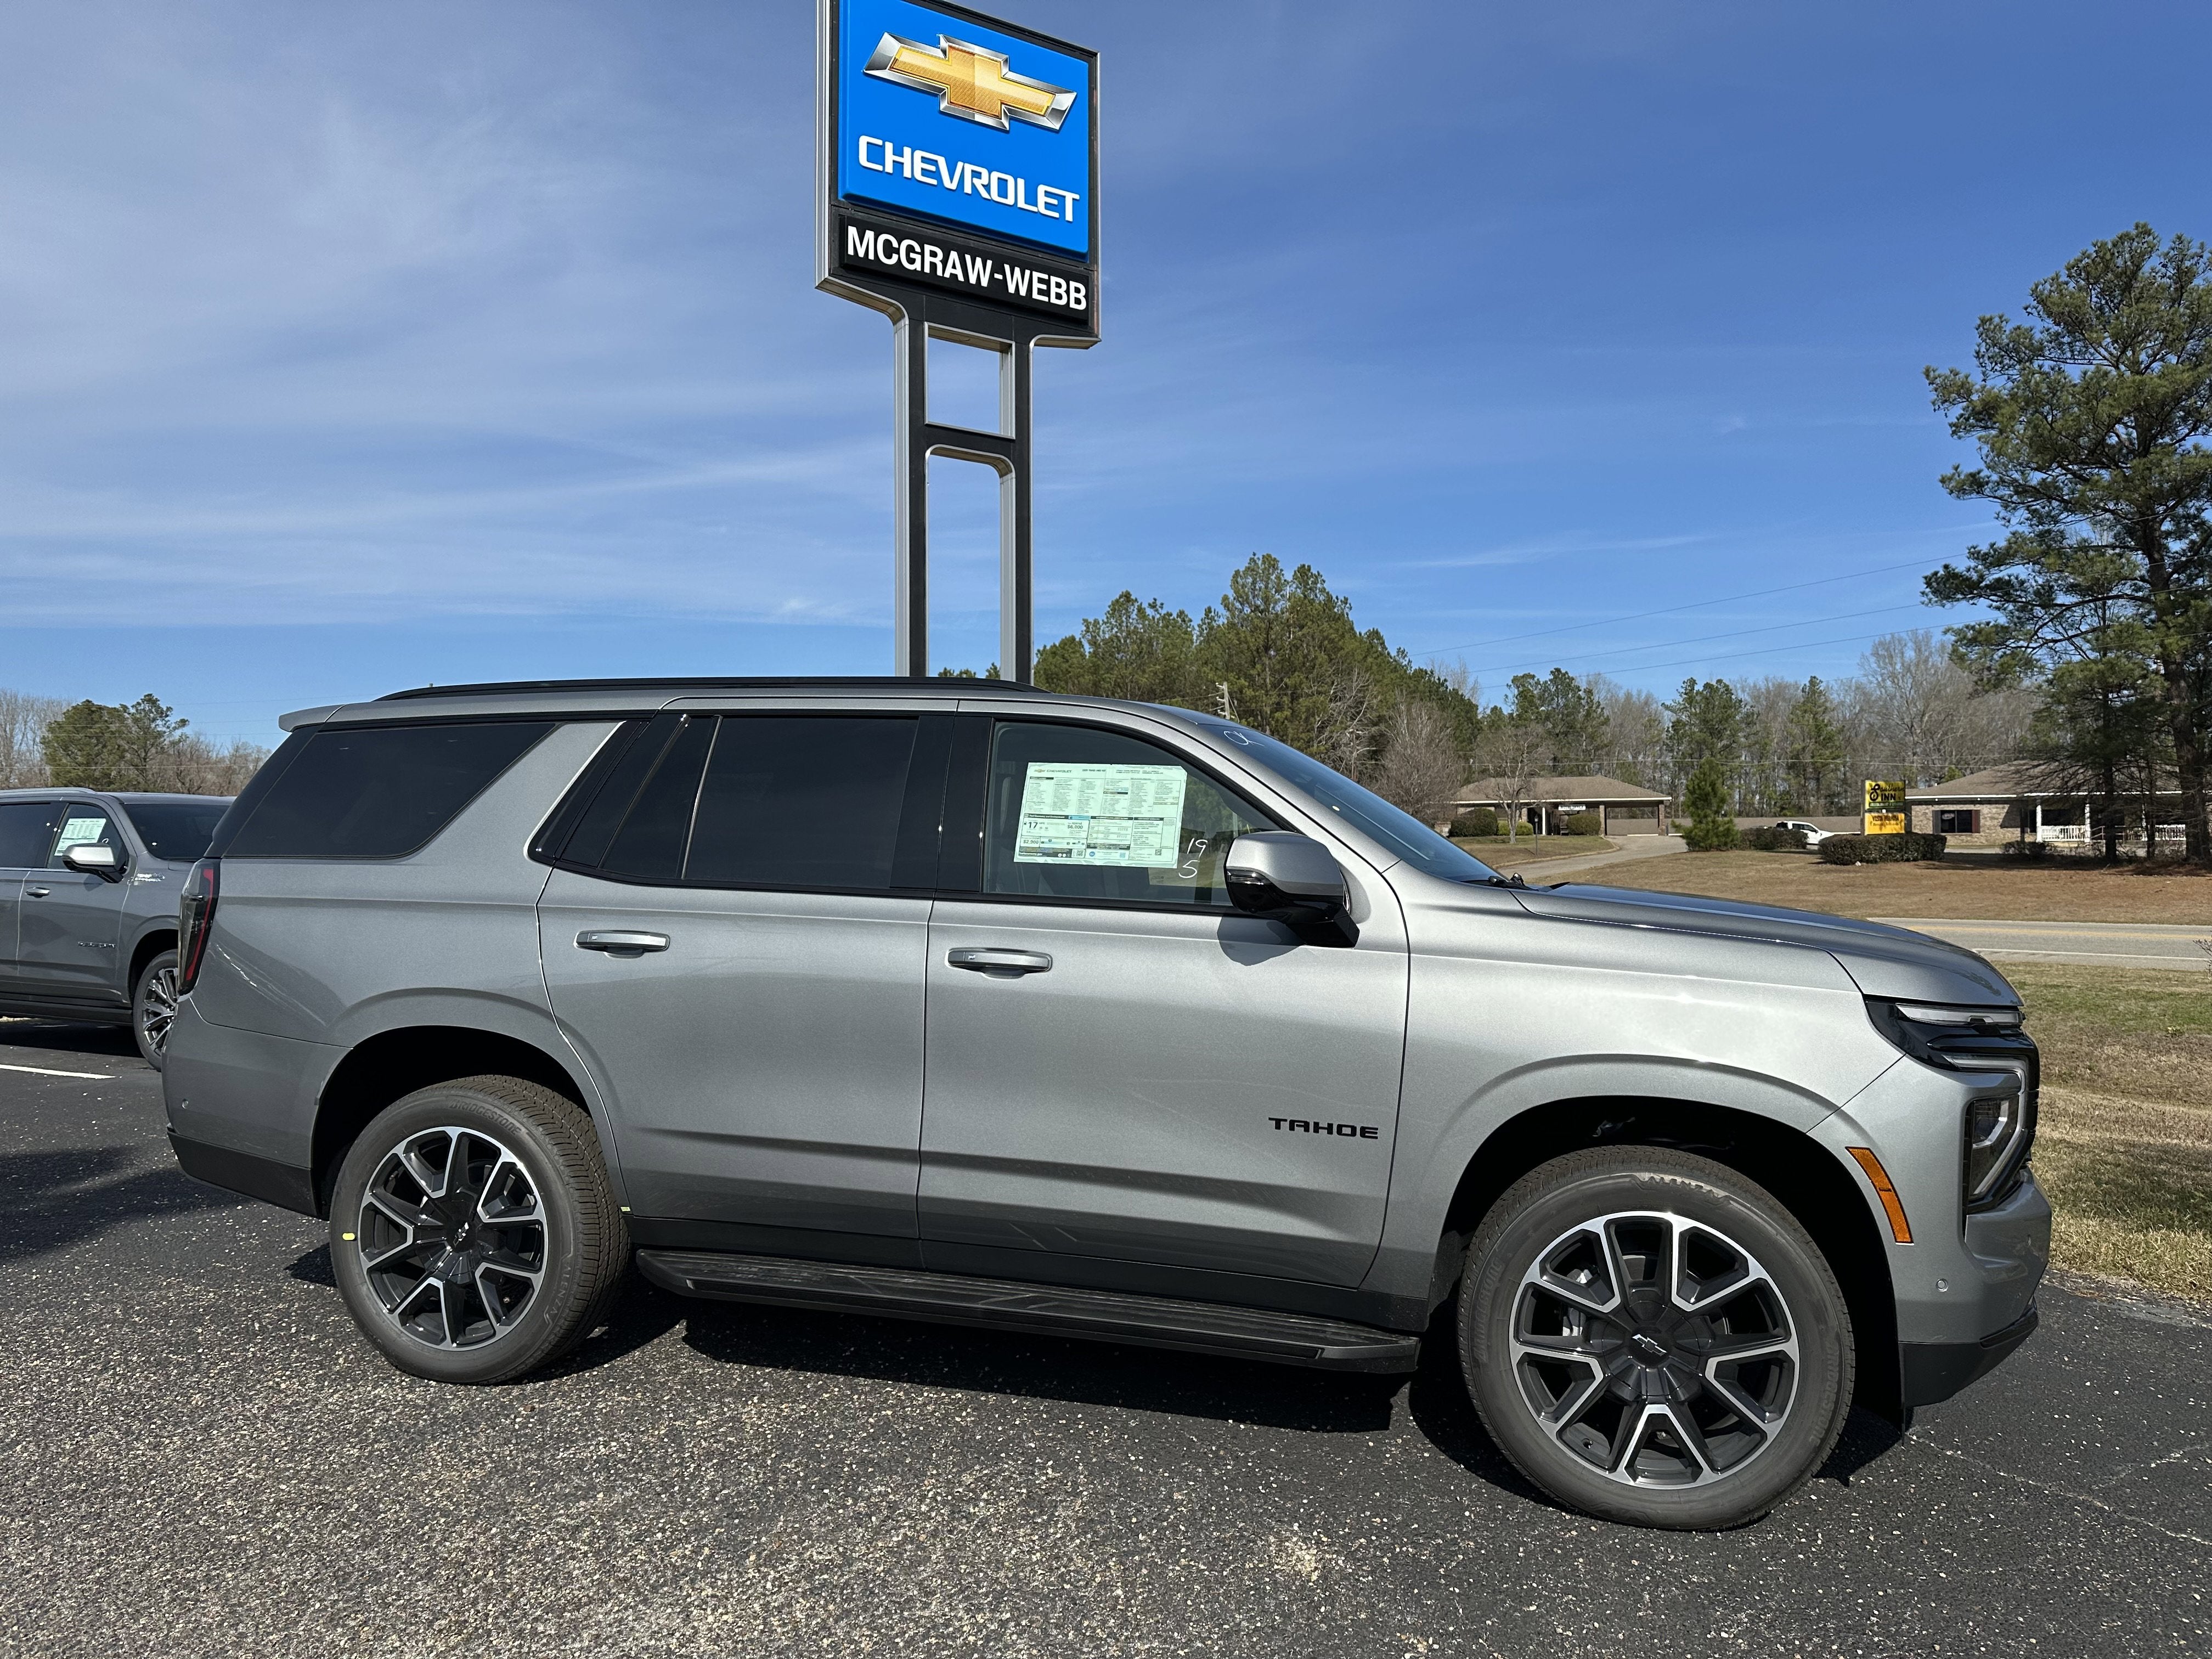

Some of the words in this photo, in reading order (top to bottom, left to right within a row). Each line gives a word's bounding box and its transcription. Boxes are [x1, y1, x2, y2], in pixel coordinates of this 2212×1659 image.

[859, 134, 1080, 222] CHEVROLET
[847, 225, 1087, 311] MCGRAW-WEBB
[1881, 793, 1896, 801] INN
[1178, 860, 1200, 878] 5
[449, 1099, 522, 1135] BRIDGESTONE
[1268, 1117, 1379, 1140] TAHOE
[550, 1263, 571, 1314] ALENZA
